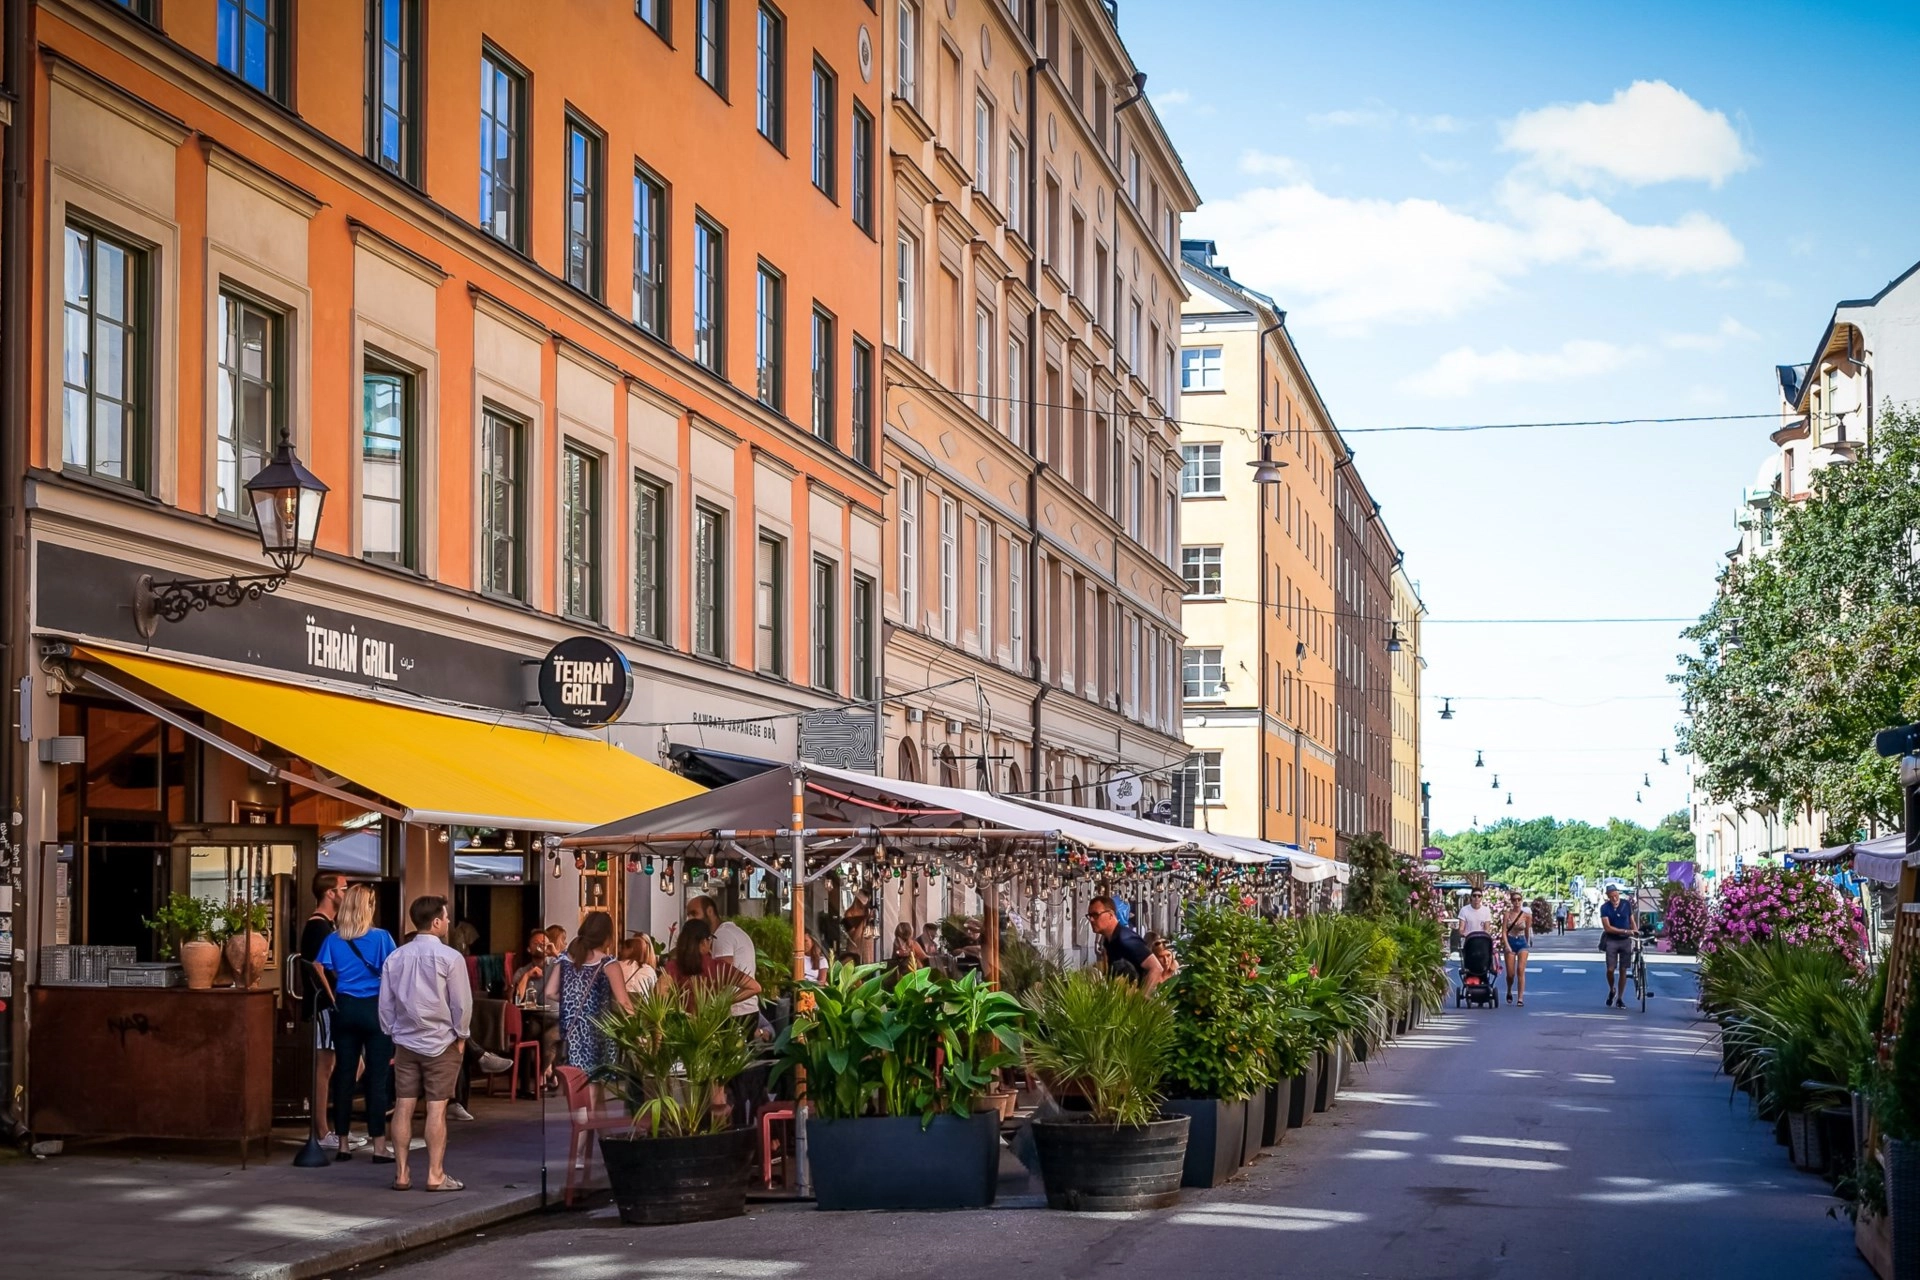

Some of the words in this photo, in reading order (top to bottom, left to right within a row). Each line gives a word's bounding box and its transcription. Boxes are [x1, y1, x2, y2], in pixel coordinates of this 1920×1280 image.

[362, 638, 398, 681] GRILL
[561, 683, 607, 706] GRILL
[727, 720, 761, 737] JAPANESE
[764, 726, 775, 740] BBQ
